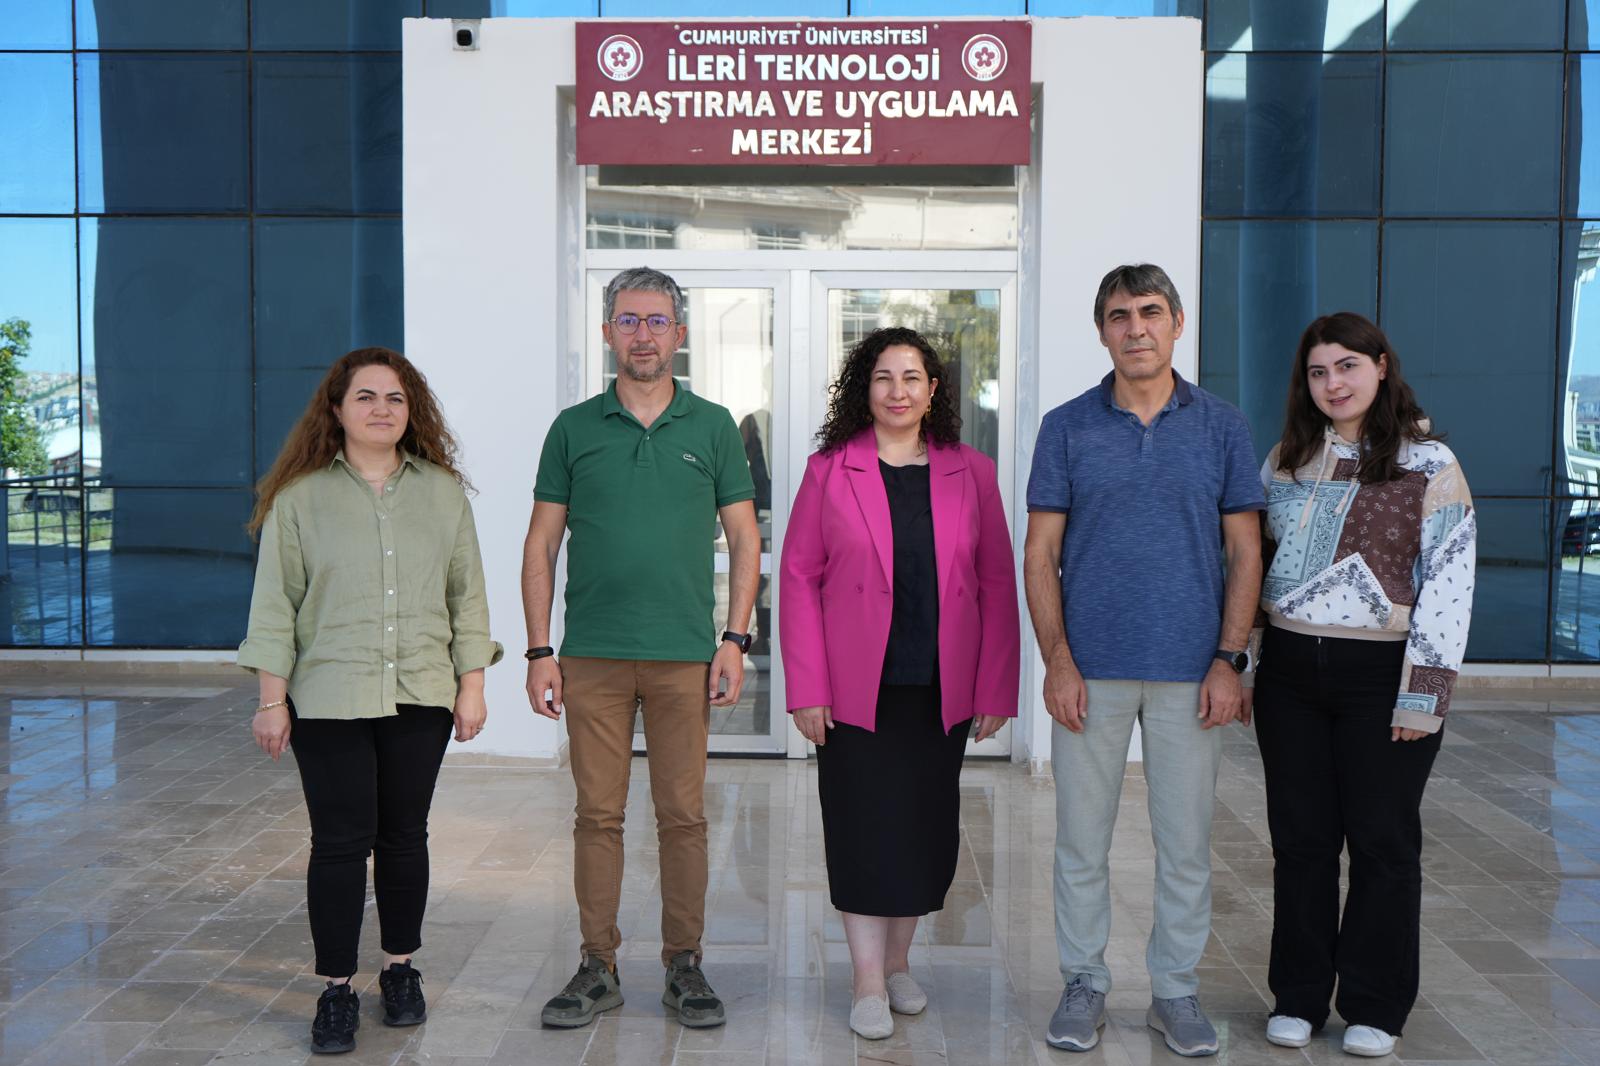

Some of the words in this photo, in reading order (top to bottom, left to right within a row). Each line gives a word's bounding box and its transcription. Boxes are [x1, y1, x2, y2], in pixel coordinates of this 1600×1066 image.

[679, 26, 800, 45] CUMHURİYET
[805, 26, 928, 45] ÜNİVERSİTESİ
[667, 48, 747, 81] İLERİ
[753, 48, 940, 81] TEKNOLOJİ
[589, 90, 777, 124] ARAŞTIRMA
[781, 90, 824, 117] VE
[835, 90, 1019, 118] UYGULAMA
[731, 122, 872, 156] MERKEZİ
